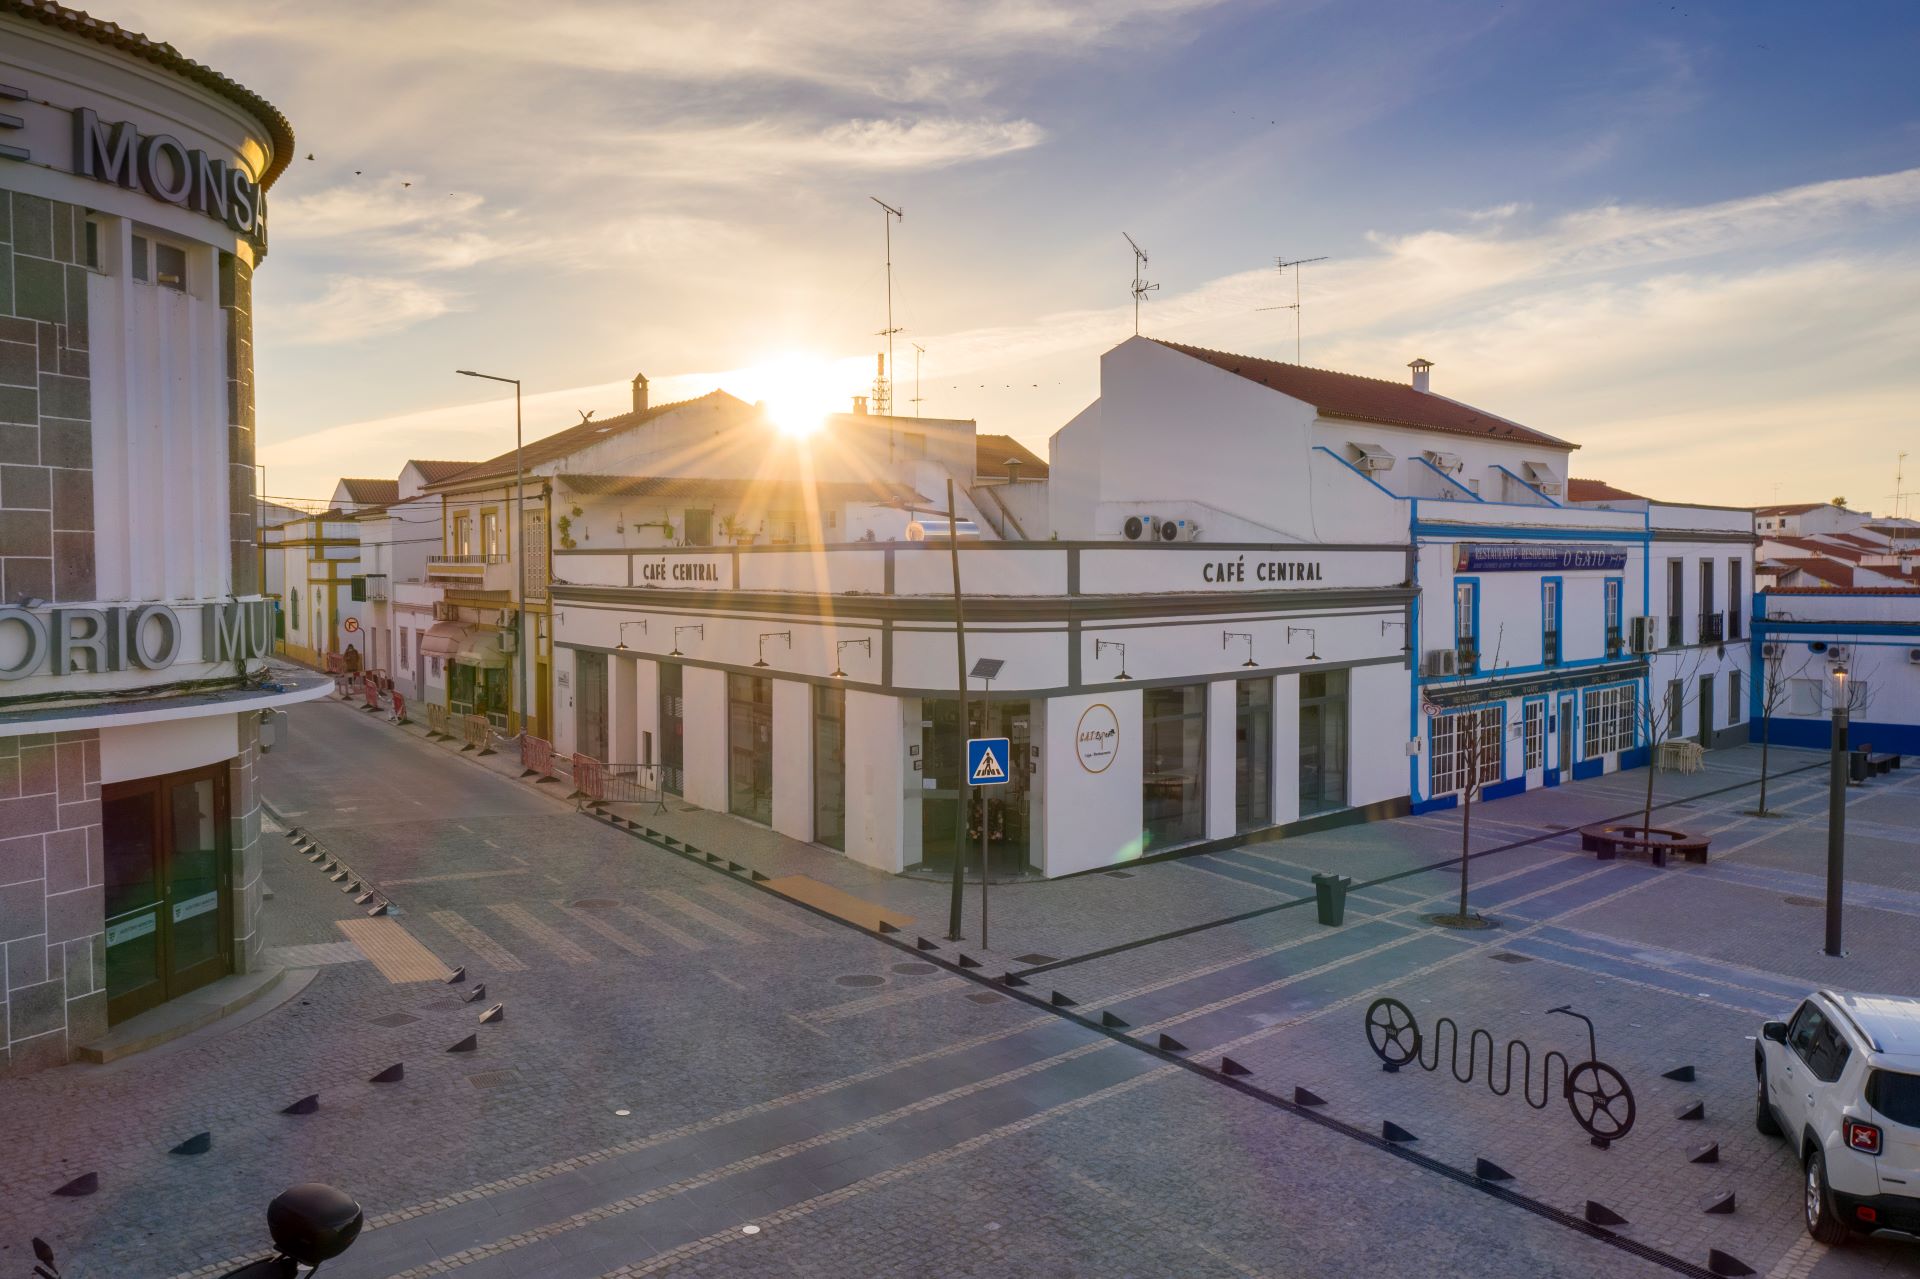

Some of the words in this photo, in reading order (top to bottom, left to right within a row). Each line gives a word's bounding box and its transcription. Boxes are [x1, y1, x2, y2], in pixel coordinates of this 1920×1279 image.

[643, 557, 666, 581] CAFÉ
[672, 563, 719, 582] CENTRAL
[1203, 554, 1245, 583] CAFÉ
[1256, 562, 1323, 581] CENTRAL
[1574, 550, 1606, 567] GATO
